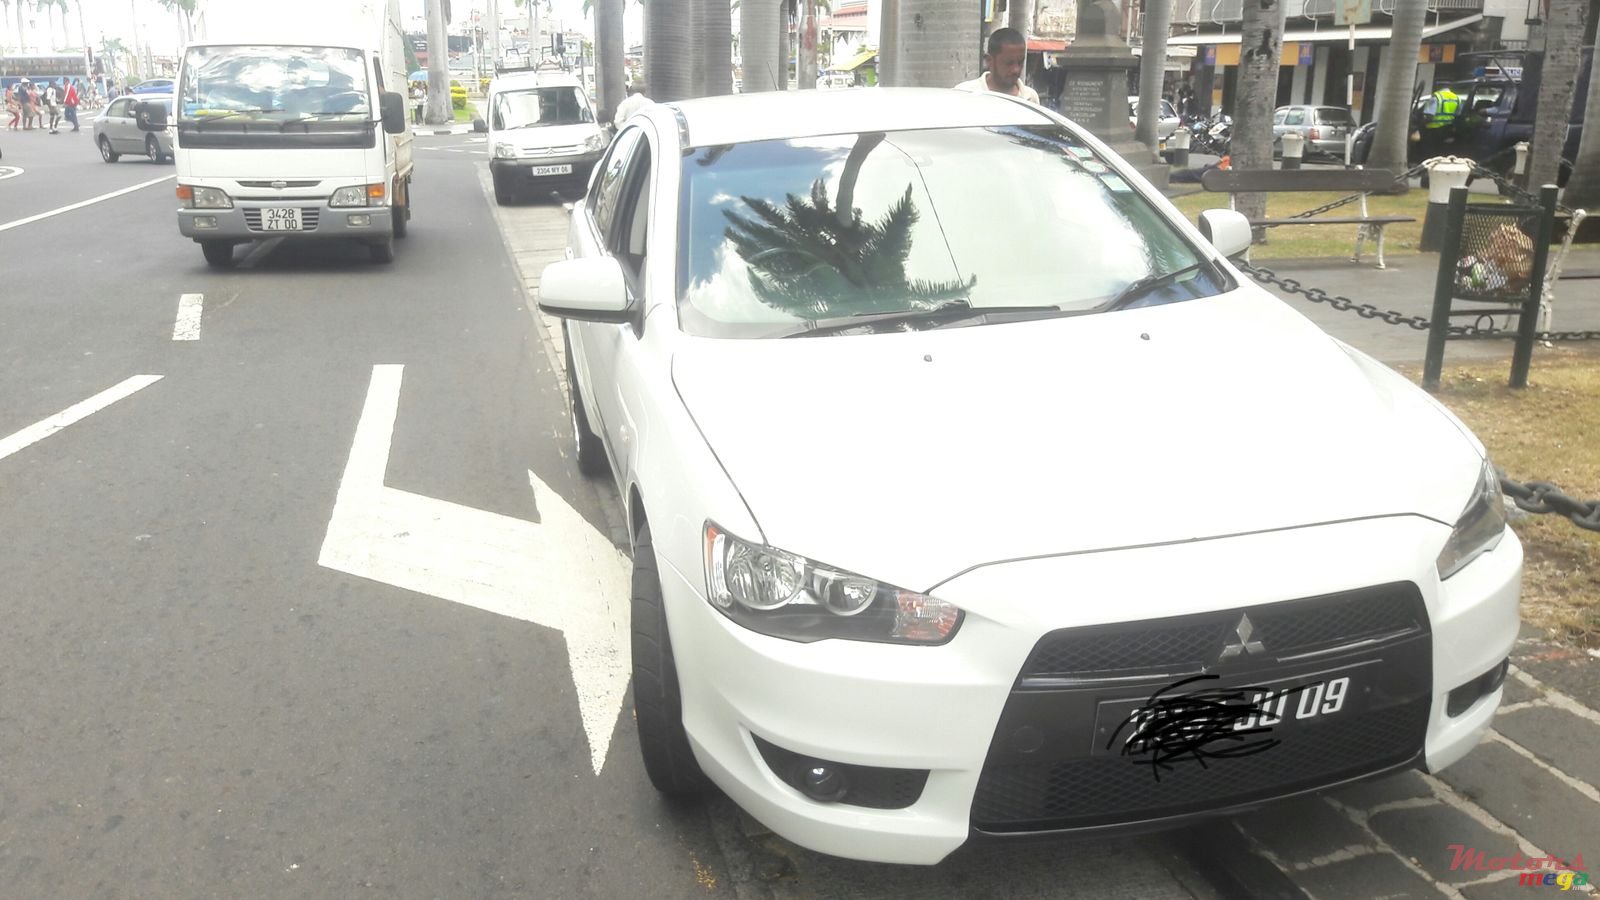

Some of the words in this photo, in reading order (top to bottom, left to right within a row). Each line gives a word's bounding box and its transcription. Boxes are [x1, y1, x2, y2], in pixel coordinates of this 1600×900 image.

[267, 208, 295, 219] 3428
[267, 219, 280, 230] ZT
[284, 219, 298, 230] 00
[1295, 676, 1350, 720] 09
